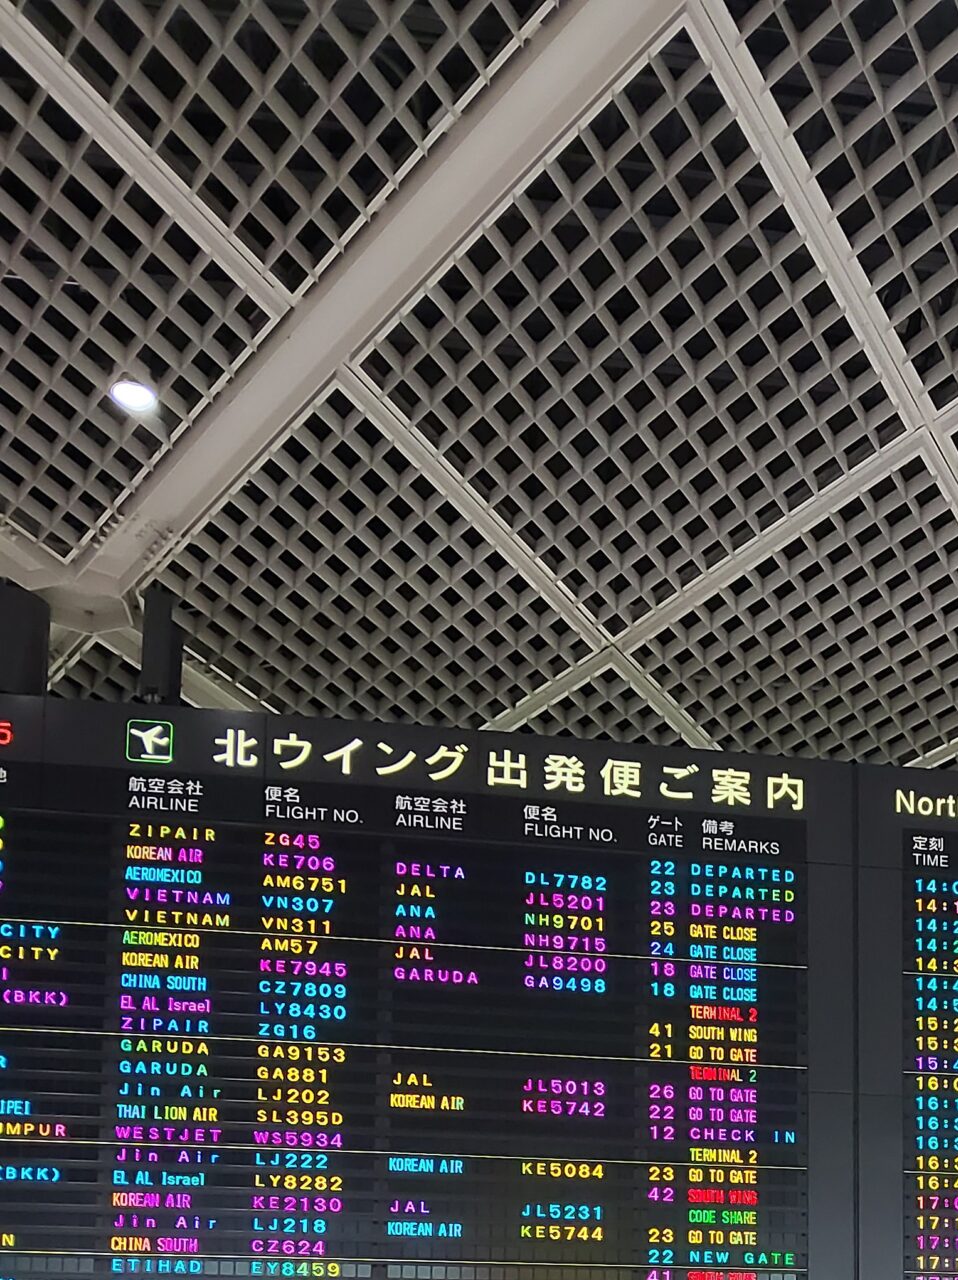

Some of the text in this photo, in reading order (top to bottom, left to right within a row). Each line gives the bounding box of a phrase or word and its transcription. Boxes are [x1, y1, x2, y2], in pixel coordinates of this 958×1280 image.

[129, 777, 203, 795] 航空会社
[265, 786, 299, 802] 便名
[129, 796, 198, 812] AIRLINE
[396, 795, 466, 814] 航空会社
[266, 805, 327, 820] FLIGHT
[524, 805, 556, 821] 便名
[396, 814, 462, 830] AIRLINE
[702, 820, 734, 835] 備考
[130, 824, 214, 841] ZIPAIR
[525, 823, 583, 839] FLIGHT
[265, 833, 320, 849] ZG45
[649, 833, 683, 847] GATE
[703, 837, 779, 854] REMARKS
[913, 836, 943, 851] 定刻
[651, 861, 675, 875] 22
[913, 853, 948, 867] TIME
[397, 862, 464, 879] DELTA
[691, 864, 794, 882] DEPARTED
[263, 875, 345, 893] AM6751
[526, 872, 606, 890] DL7782
[127, 888, 230, 905] VIETNAM
[396, 884, 435, 897] JAL
[262, 896, 333, 913] VN307
[396, 905, 435, 918] ANA
[0, 924, 59, 938] CITY
[651, 921, 674, 936] 25
[690, 924, 756, 941] GATE CLOSE
[394, 967, 478, 984] GARUDA
[525, 975, 605, 993] GA9498
[649, 1023, 671, 1037] 41
[689, 1025, 757, 1042] SOUTH WING
[258, 1045, 345, 1062] GA9153
[524, 1079, 604, 1095] JL5013
[116, 1126, 221, 1142] WESTJET
[651, 1126, 674, 1140] 12
[690, 1128, 794, 1143] CHECK IN
[522, 1163, 603, 1178] KE5084
[256, 1175, 342, 1190] LY8282
[112, 1259, 202, 1274] ETIHAD
